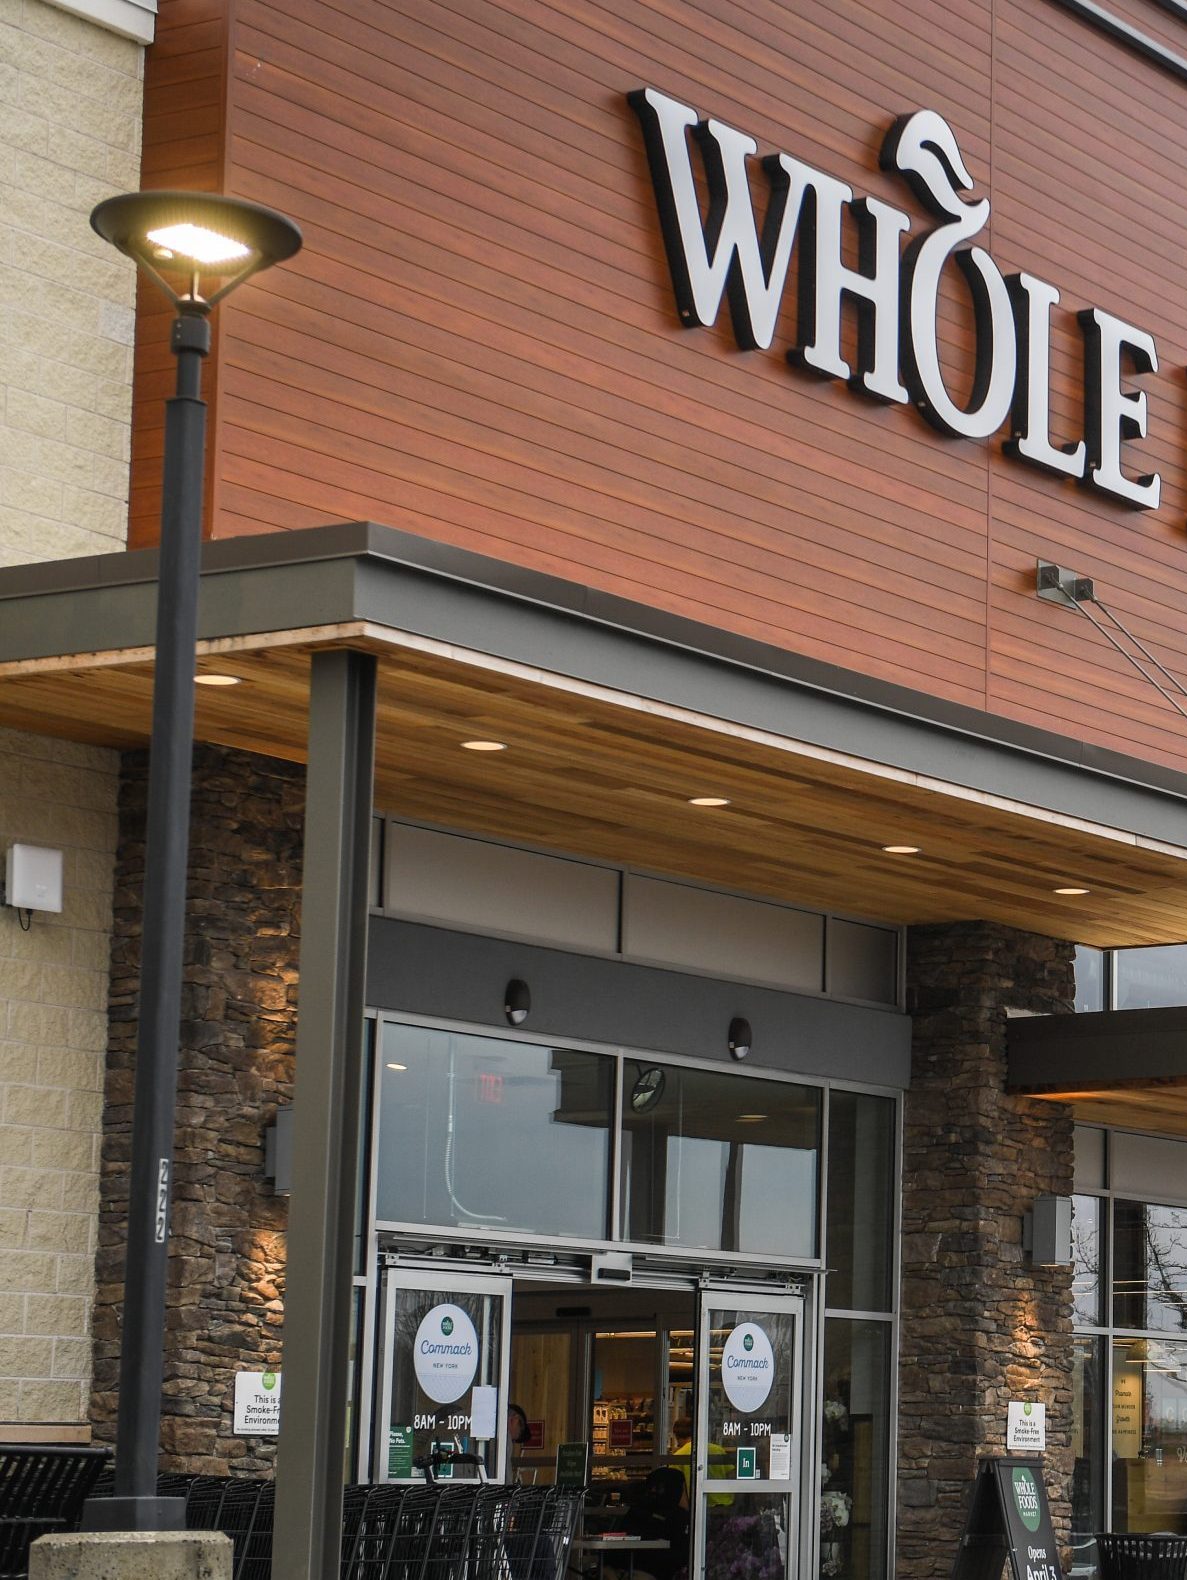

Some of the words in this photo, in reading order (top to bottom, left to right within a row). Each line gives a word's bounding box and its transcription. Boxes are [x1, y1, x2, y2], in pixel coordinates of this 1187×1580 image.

[630, 87, 1161, 510] WHOLE
[421, 1339, 472, 1355] Commack
[727, 1355, 769, 1369] Commack
[254, 1395, 269, 1404] This
[270, 1396, 276, 1404] is
[246, 1405, 280, 1414] Smoke-Fr
[244, 1415, 280, 1425] Environme
[413, 1414, 436, 1430] 8AM
[447, 1415, 472, 1430] 10PM
[723, 1422, 741, 1436] 8AM
[750, 1422, 771, 1437] 10PM
[1014, 1475, 1036, 1495] WHOLE
[1018, 1495, 1038, 1509] FOODS
[1027, 1545, 1046, 1562] Opens
